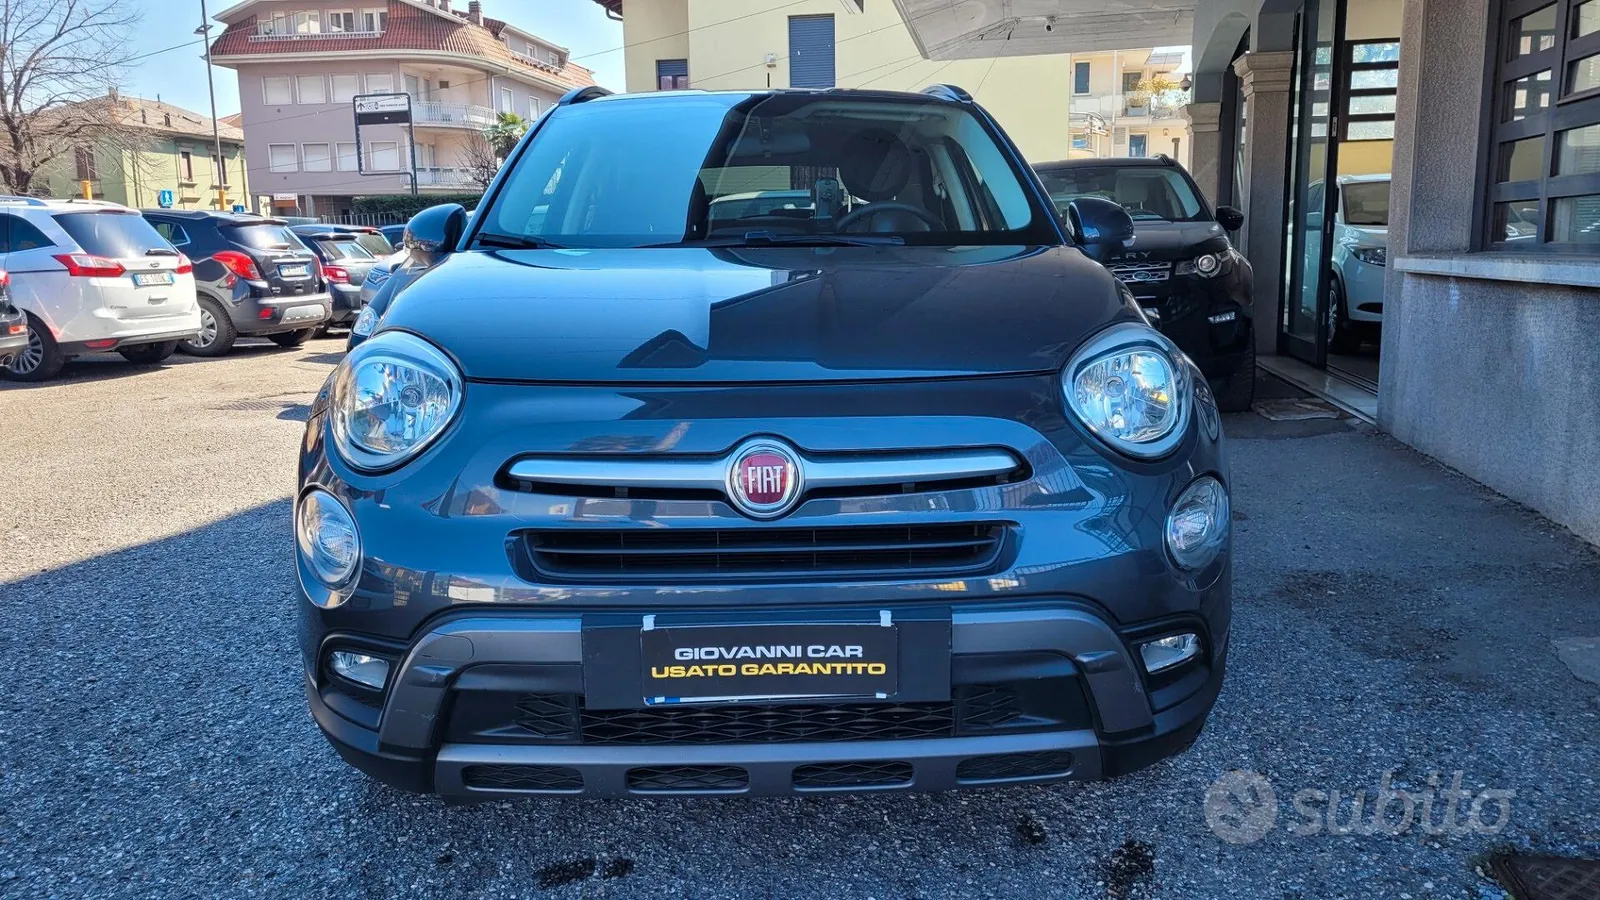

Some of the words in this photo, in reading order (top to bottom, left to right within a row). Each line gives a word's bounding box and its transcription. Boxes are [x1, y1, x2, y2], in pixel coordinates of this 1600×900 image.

[747, 466, 783, 494] FIAT
[674, 645, 802, 660] GIOVANNI
[807, 645, 863, 658] CAR
[651, 664, 737, 678] USATO
[741, 662, 887, 677] GARANTITO
